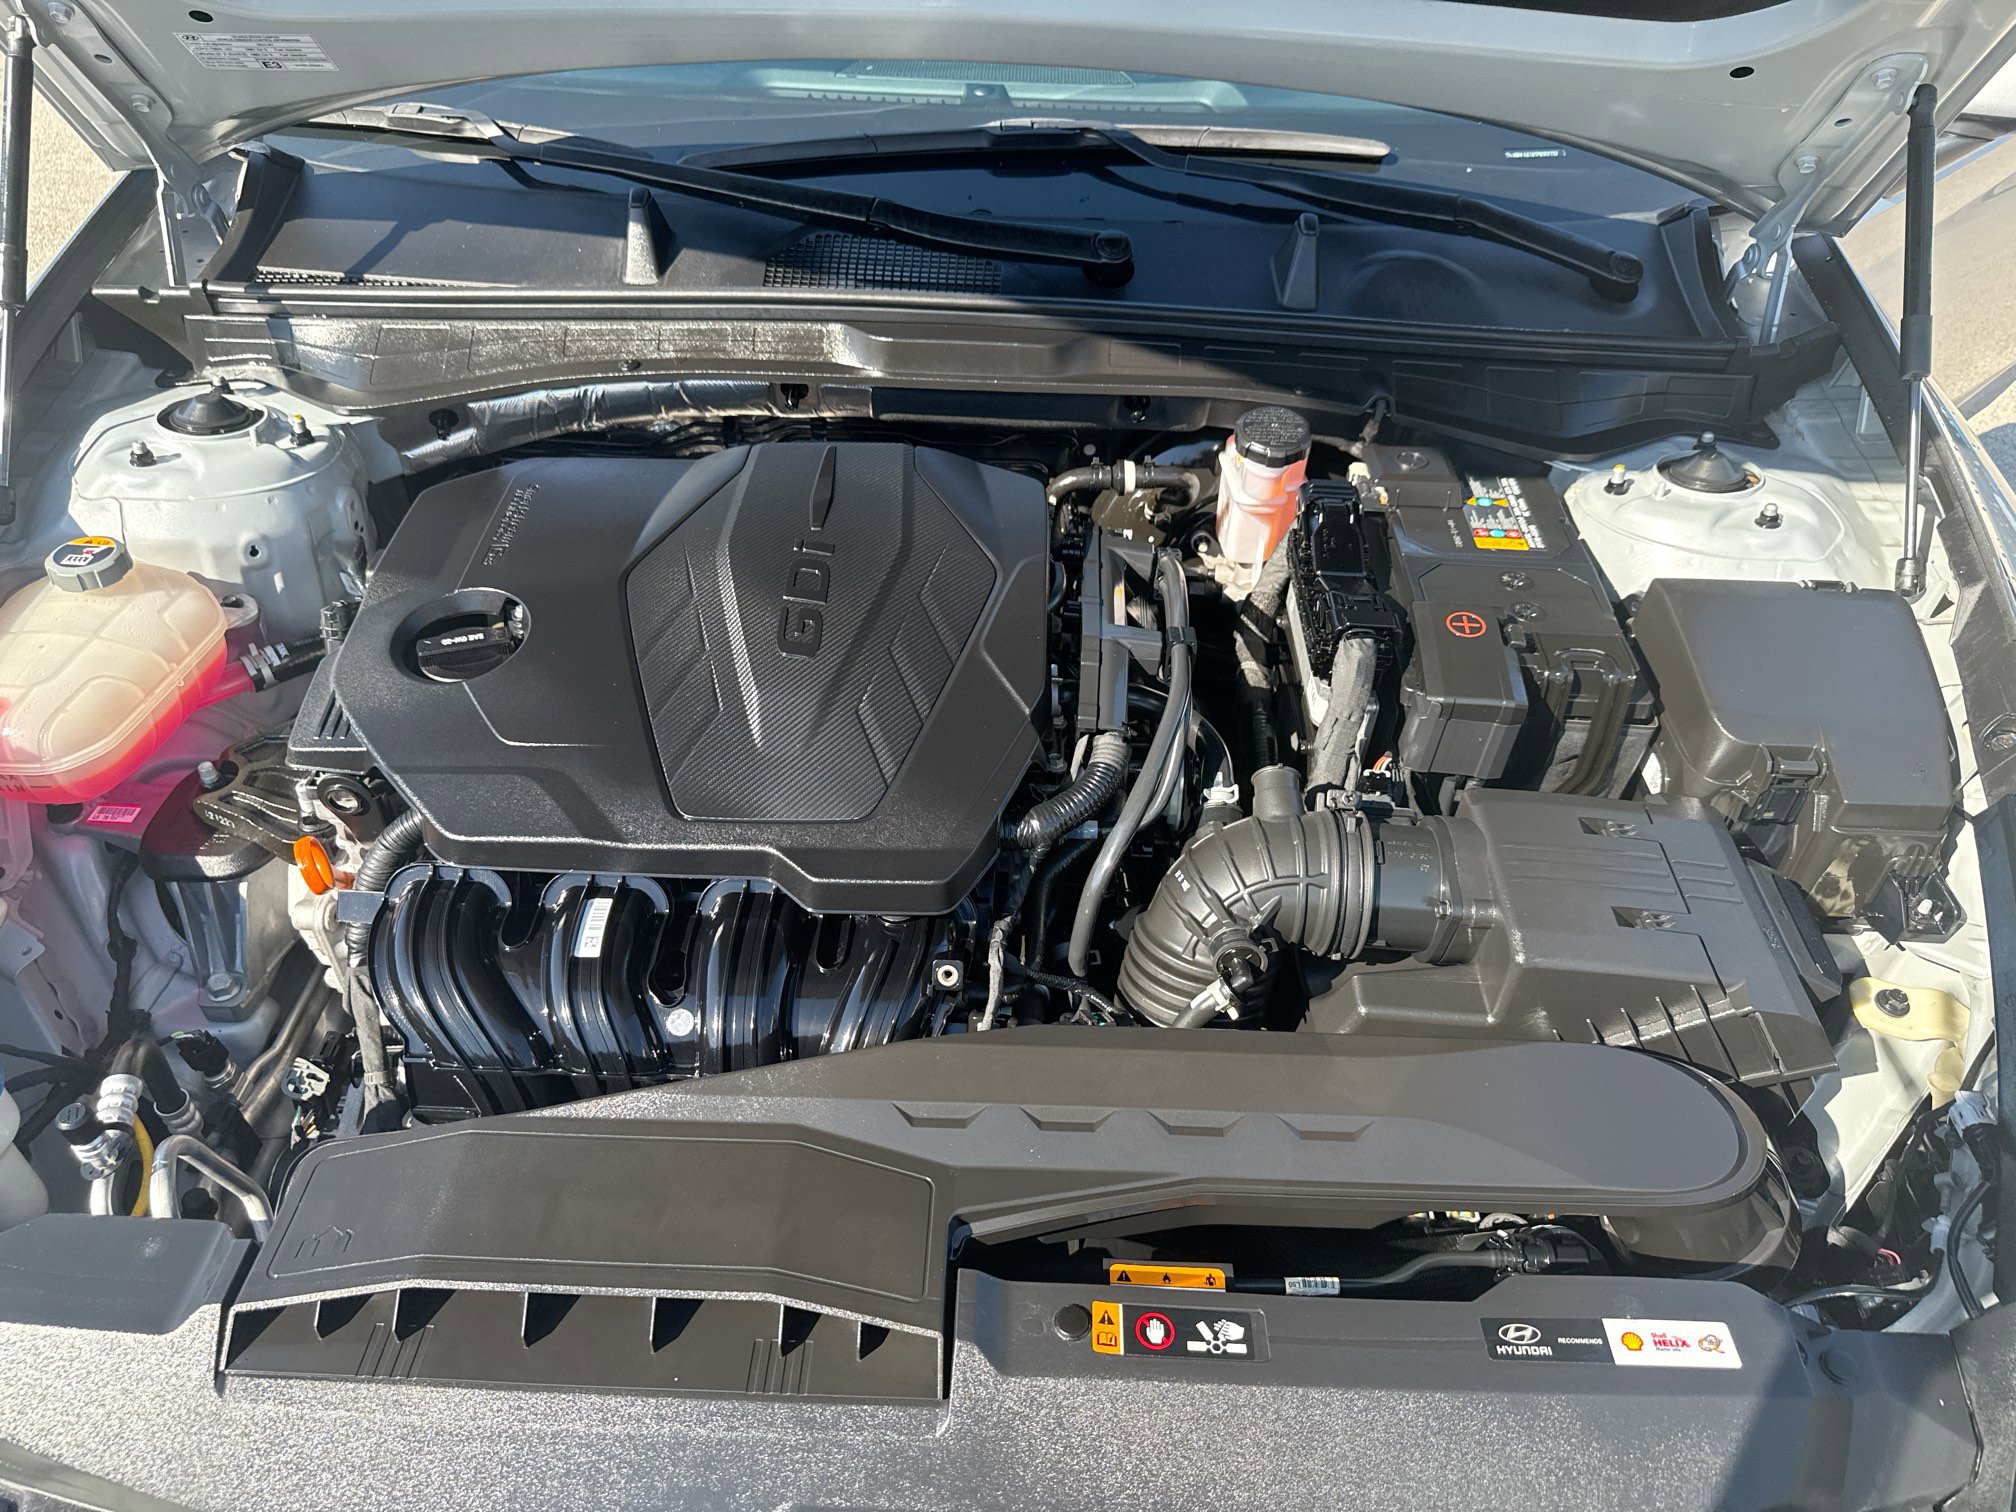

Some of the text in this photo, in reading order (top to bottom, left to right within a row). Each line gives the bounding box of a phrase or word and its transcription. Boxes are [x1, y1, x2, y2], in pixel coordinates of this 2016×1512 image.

[262, 61, 282, 69] E3
[467, 632, 485, 642] SAE
[1557, 1337, 1603, 1345] RECOMMENDS
[1652, 1336, 1691, 1348] HELIX
[1496, 1345, 1553, 1356] HYUNDAI
